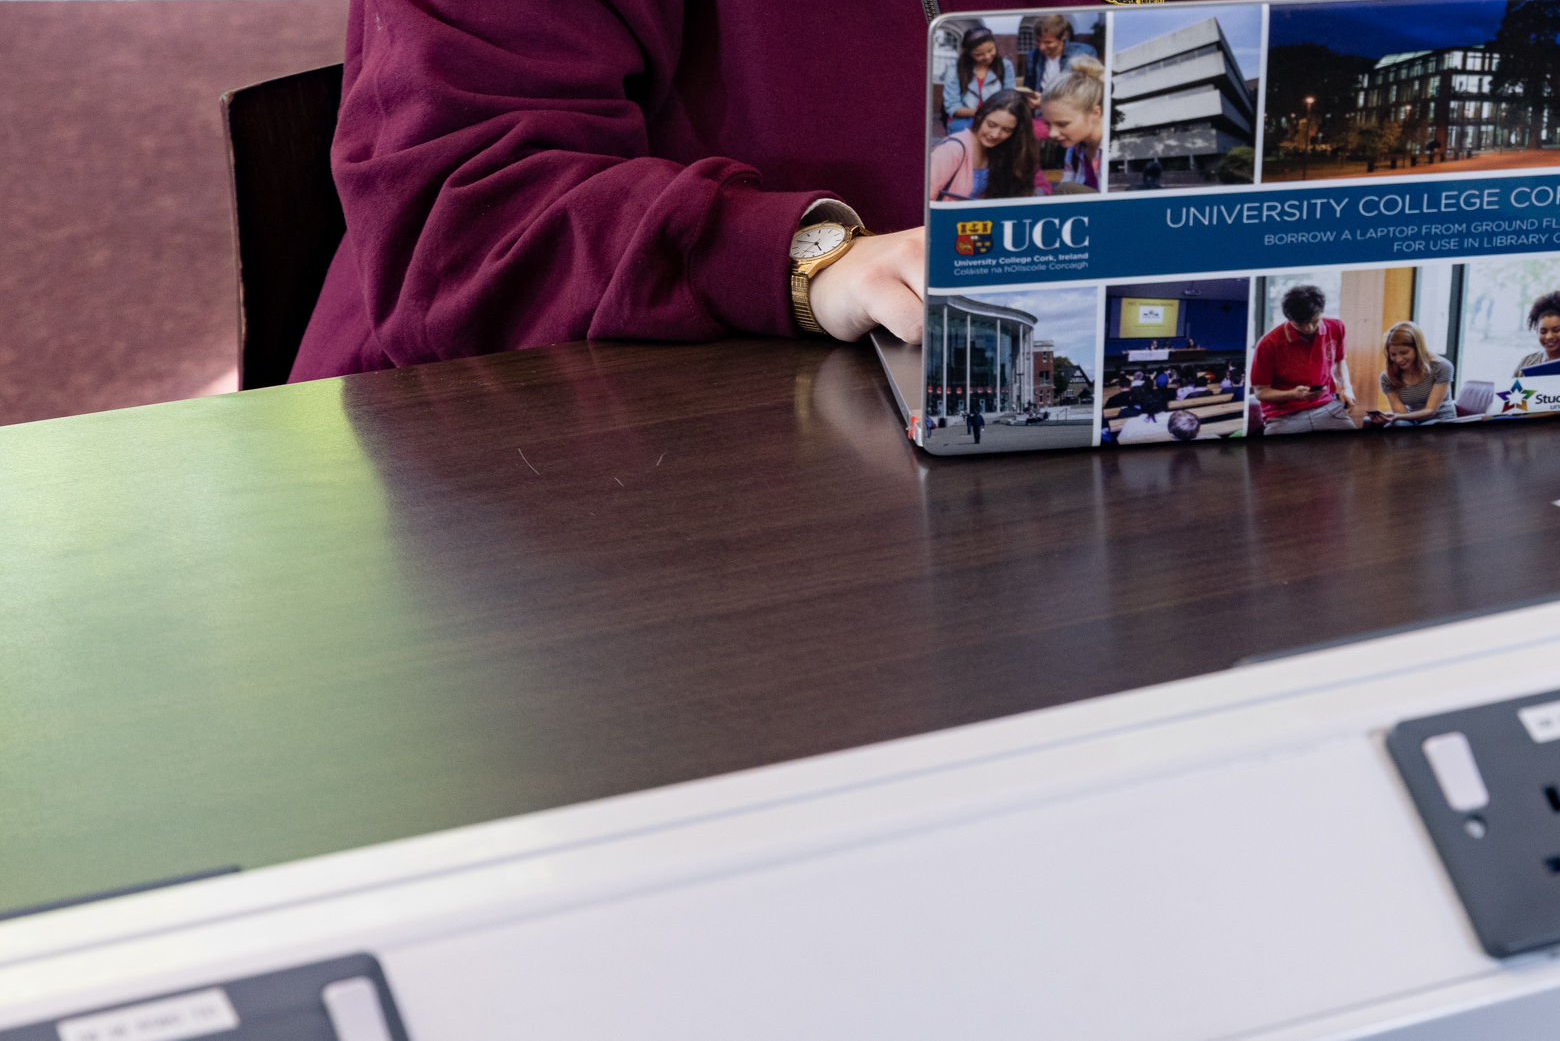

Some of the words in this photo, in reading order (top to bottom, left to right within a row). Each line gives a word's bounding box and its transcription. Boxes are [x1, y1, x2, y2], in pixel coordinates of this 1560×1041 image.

[1166, 197, 1349, 228] UNIVERSITY
[1359, 189, 1501, 217] COLLEGE
[1001, 216, 1090, 252] UCC
[1264, 231, 1336, 246] BORROW
[1341, 230, 1352, 241] A
[1357, 225, 1418, 240] LAPTOP
[1422, 222, 1467, 236] FROM
[1471, 219, 1539, 233] GROUND
[1393, 240, 1425, 253] FOR
[1430, 238, 1459, 251] USE
[1464, 237, 1479, 248] IN
[1484, 233, 1549, 248] LIBRARY
[954, 258, 997, 267] University
[999, 255, 1032, 265] College
[1033, 253, 1057, 263] Cork,
[1058, 252, 1089, 261] Ireland
[954, 267, 989, 276] Coláiste
[1049, 261, 1088, 271] Corcaigh
